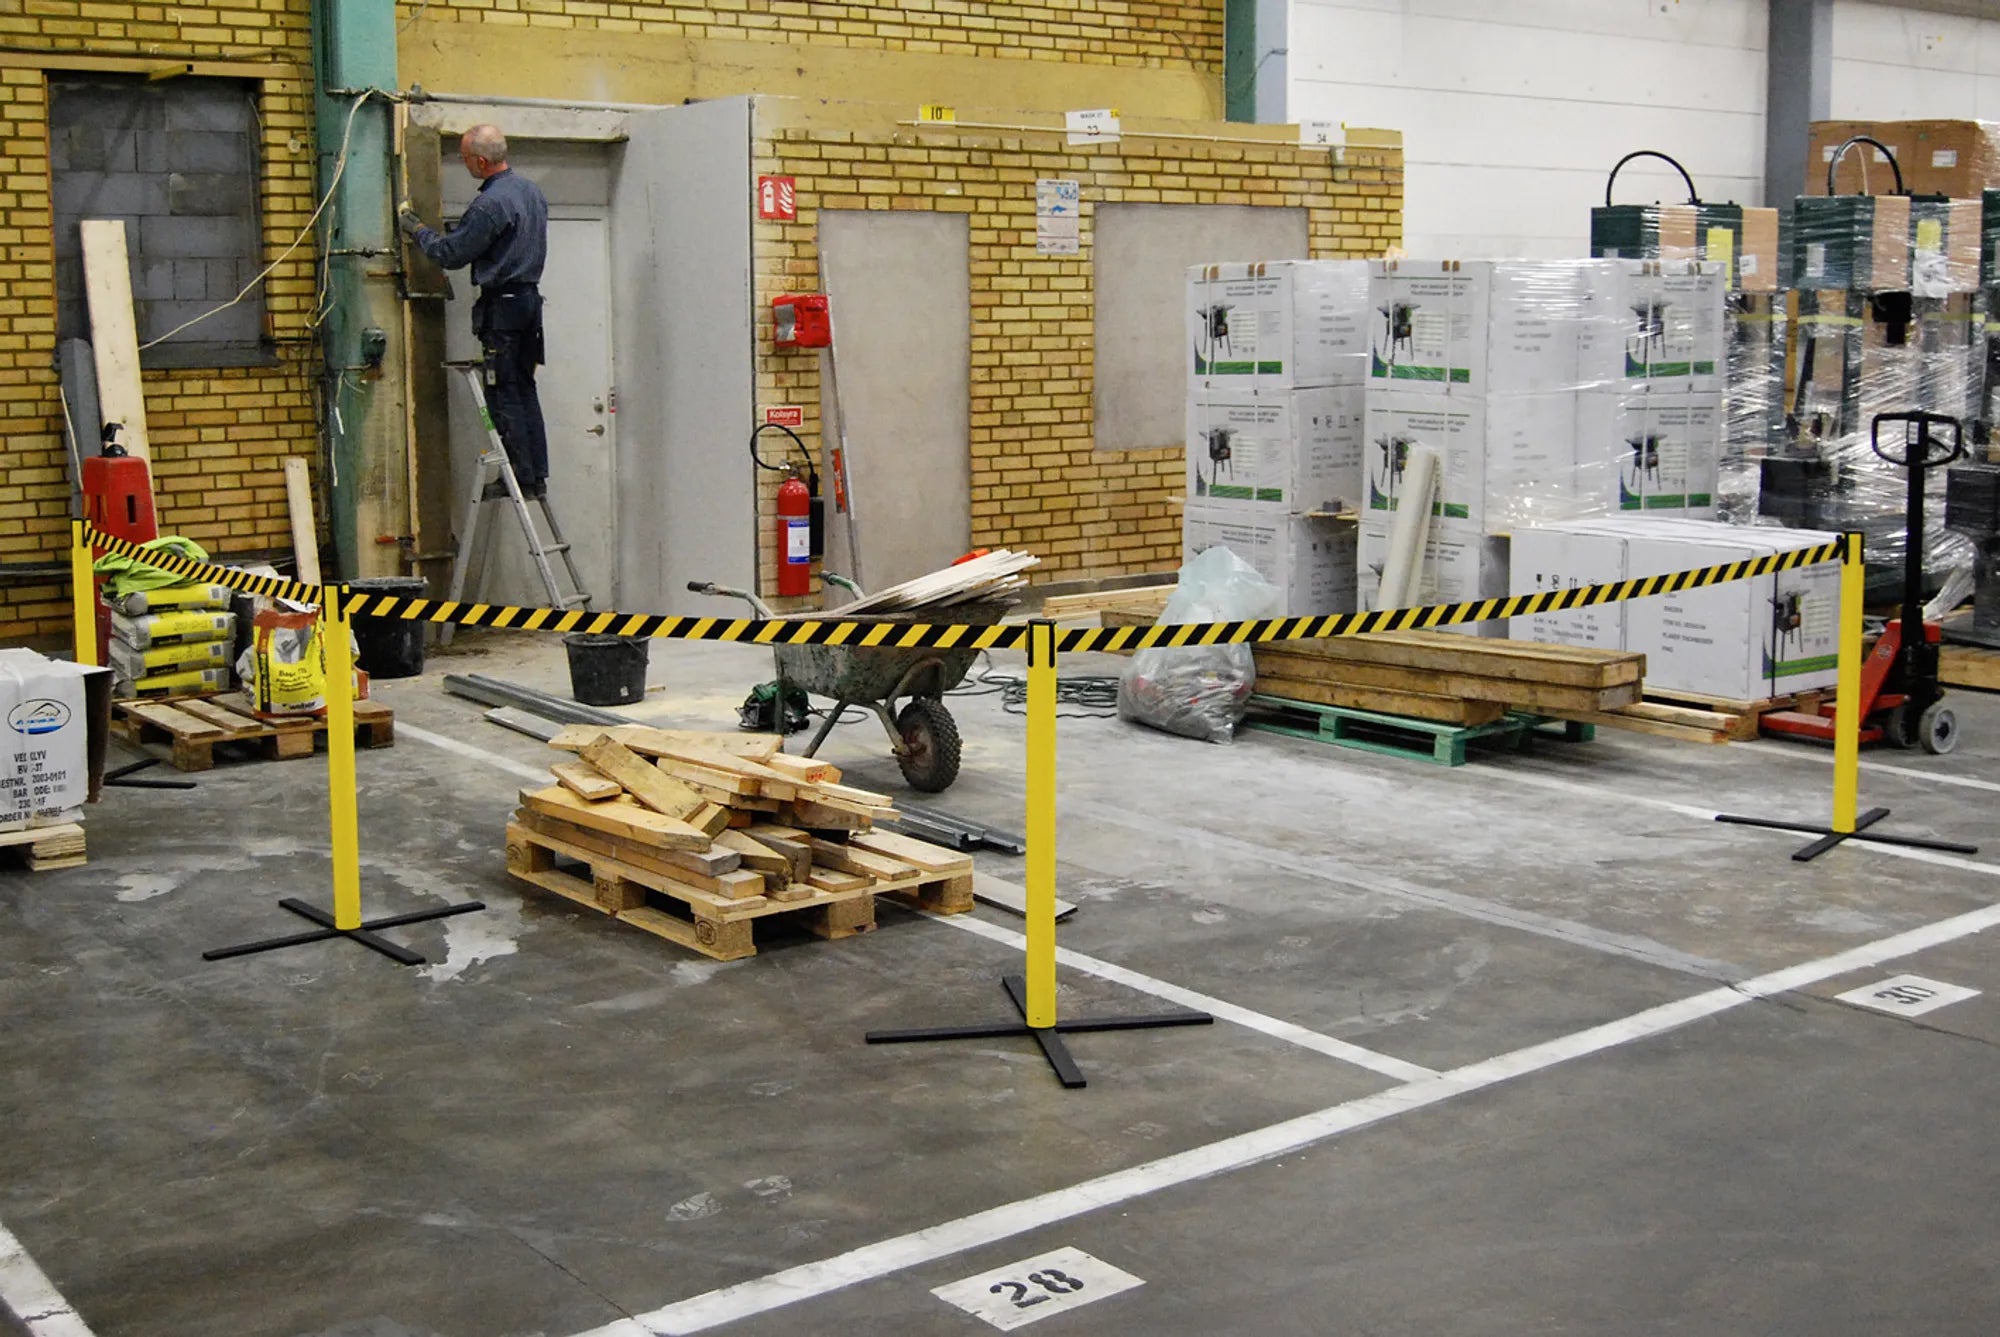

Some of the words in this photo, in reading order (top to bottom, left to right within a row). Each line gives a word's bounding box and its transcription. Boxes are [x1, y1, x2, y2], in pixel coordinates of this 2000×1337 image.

[931, 106, 943, 120] 10
[1873, 985, 1938, 1004] 30
[989, 1268, 1084, 1308] 28
